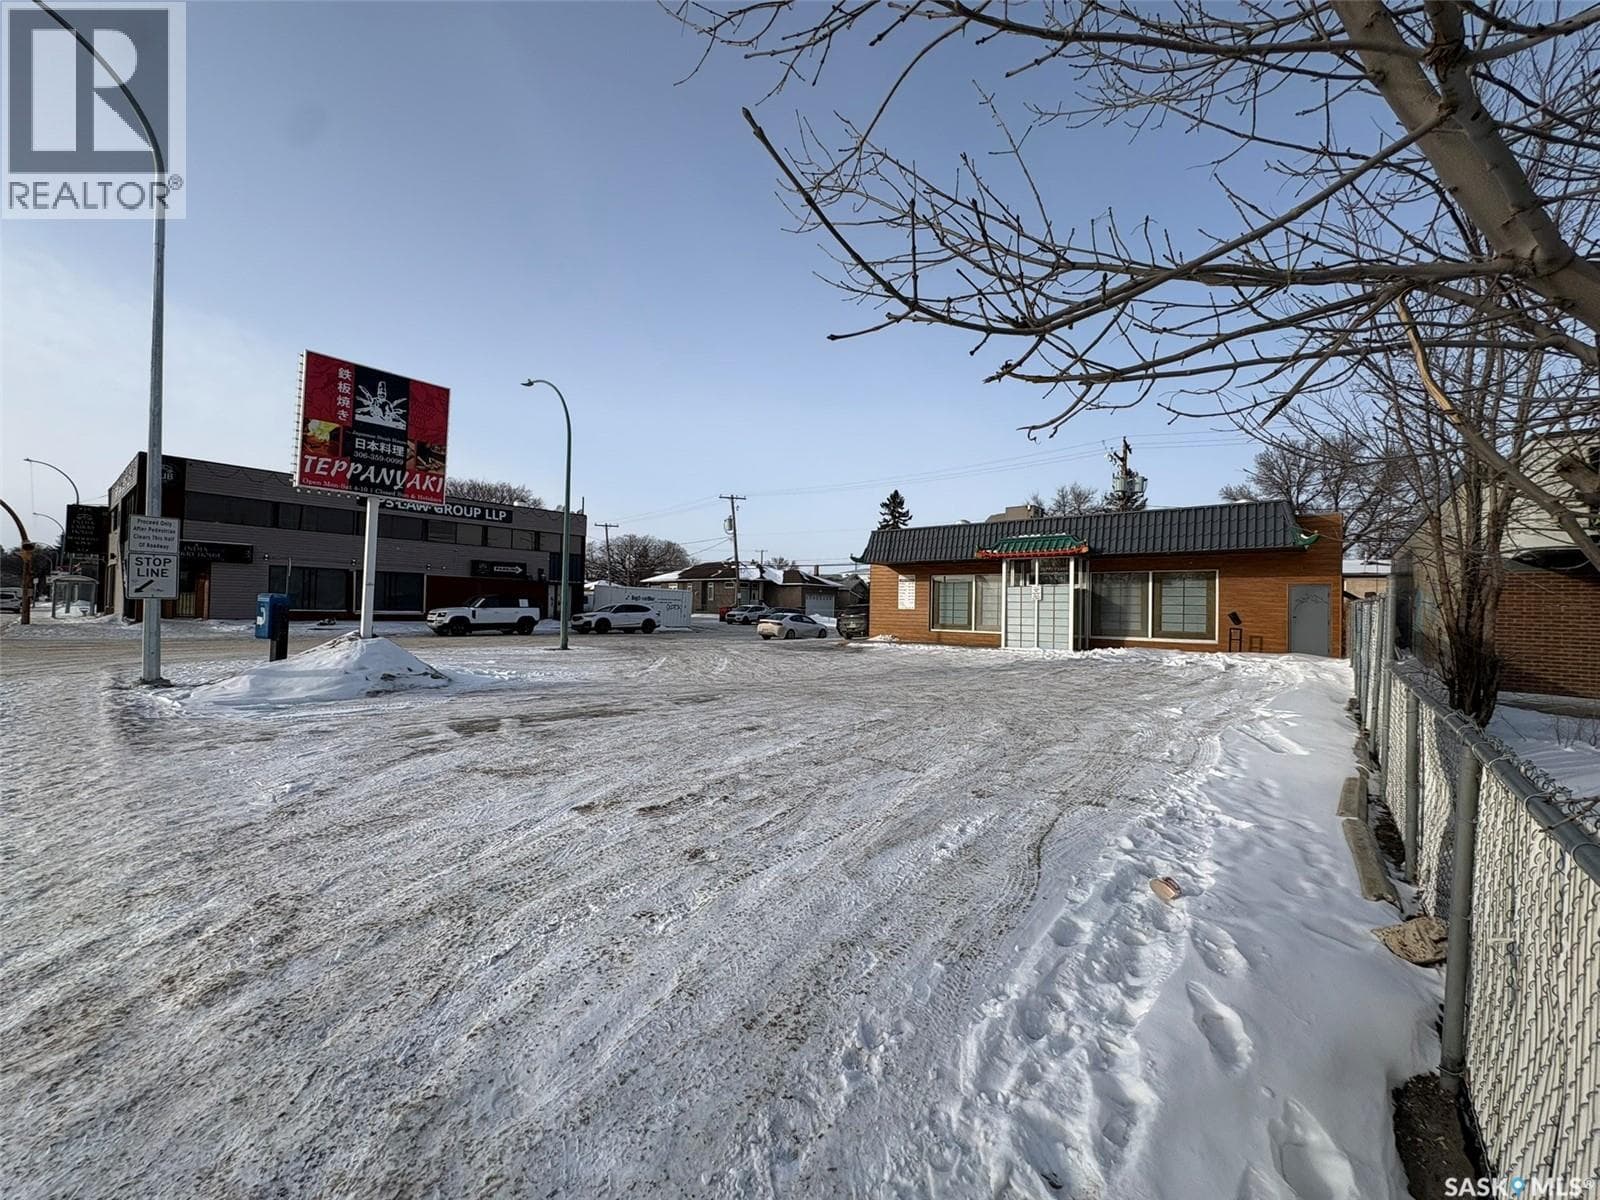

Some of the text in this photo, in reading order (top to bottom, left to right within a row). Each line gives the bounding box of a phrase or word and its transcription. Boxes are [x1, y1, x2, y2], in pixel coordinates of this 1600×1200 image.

[355, 437, 405, 457] 日本料理
[304, 454, 444, 493] TEPPANYAKI
[434, 504, 482, 518] GROUP
[485, 509, 507, 521] LLP
[160, 520, 172, 528] Only
[135, 556, 172, 567] STOP
[137, 567, 169, 578] LINE
